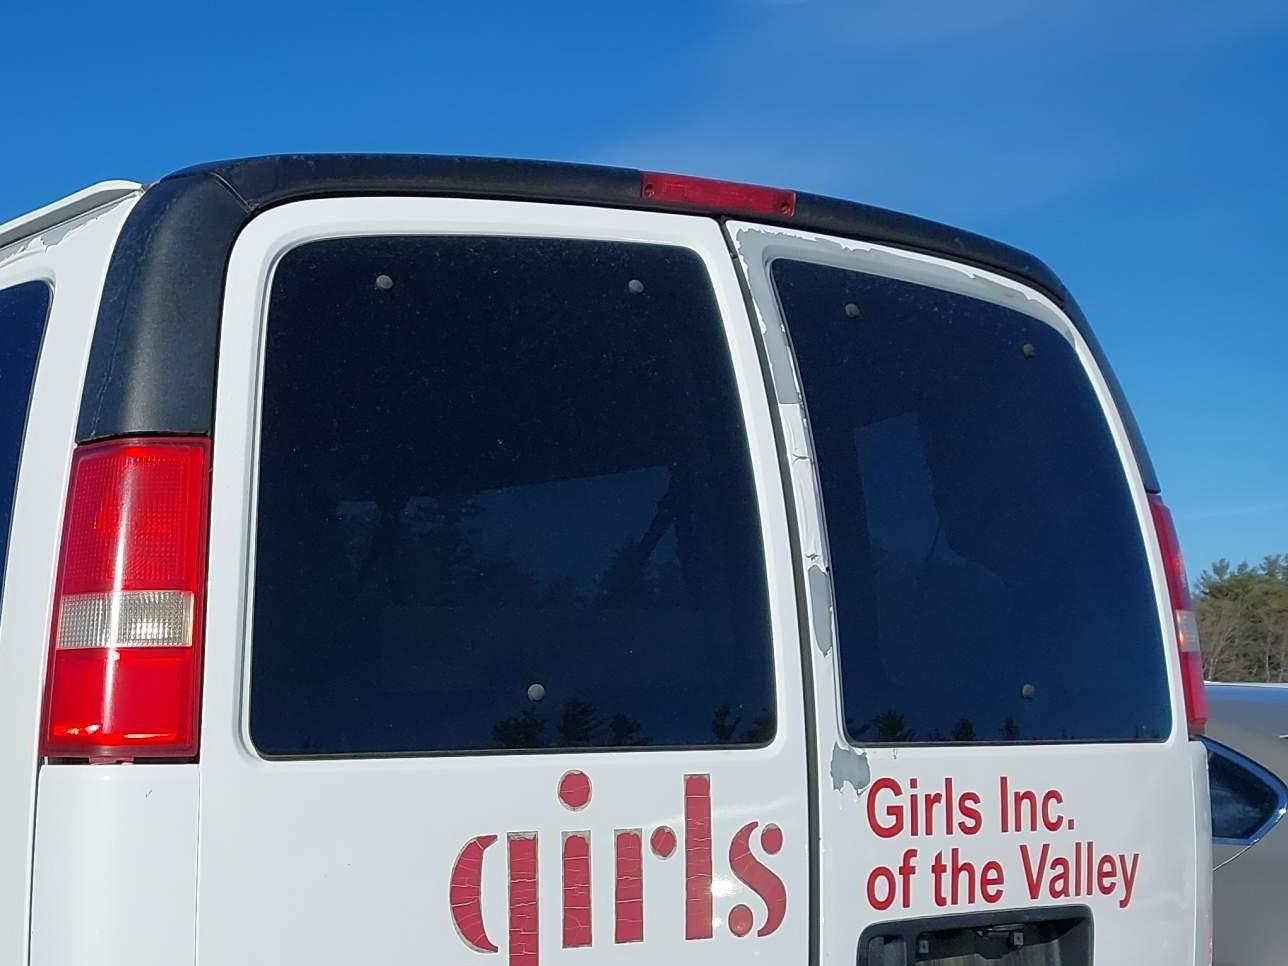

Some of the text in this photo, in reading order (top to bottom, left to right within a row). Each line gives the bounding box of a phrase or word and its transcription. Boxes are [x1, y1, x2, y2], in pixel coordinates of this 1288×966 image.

[866, 776, 1076, 840] Girls Inc.
[866, 842, 1140, 913] of the Valley
